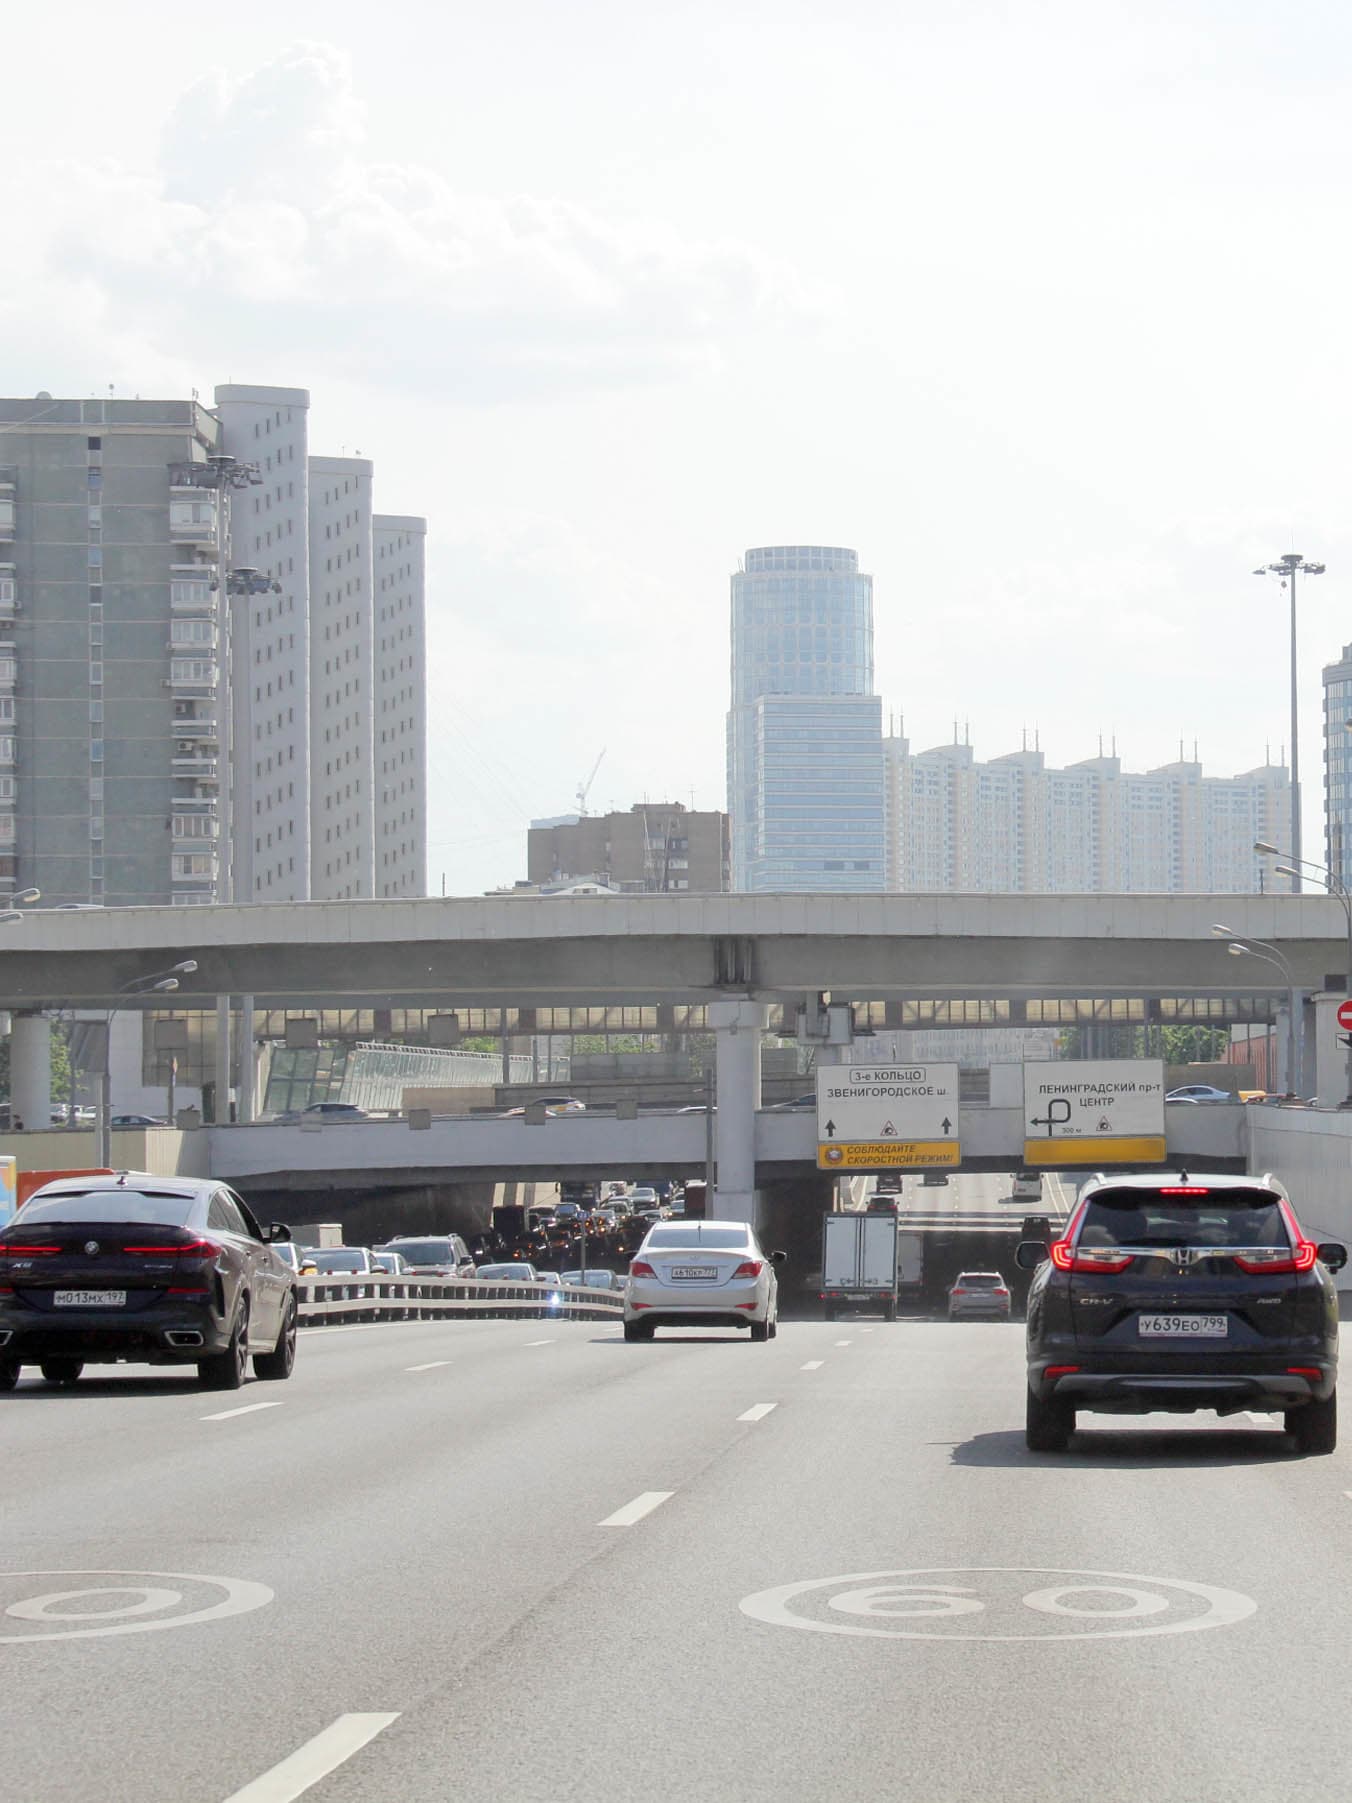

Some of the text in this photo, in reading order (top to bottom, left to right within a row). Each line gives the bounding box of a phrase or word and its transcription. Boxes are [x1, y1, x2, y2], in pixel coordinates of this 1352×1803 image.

[855, 1070, 922, 1082] 3-е КОЛЬЦО
[827, 1086, 934, 1098] ЗВЕНИГОРОДСКОЕ
[1039, 1081, 1161, 1094] ЛЕНИНГРАДСКИЙ пр-т
[1079, 1097, 1115, 1107] ЦЕНТР
[847, 1154, 913, 1165] СКОРОСТНОЙ
[827, 1584, 1170, 1617] 60
